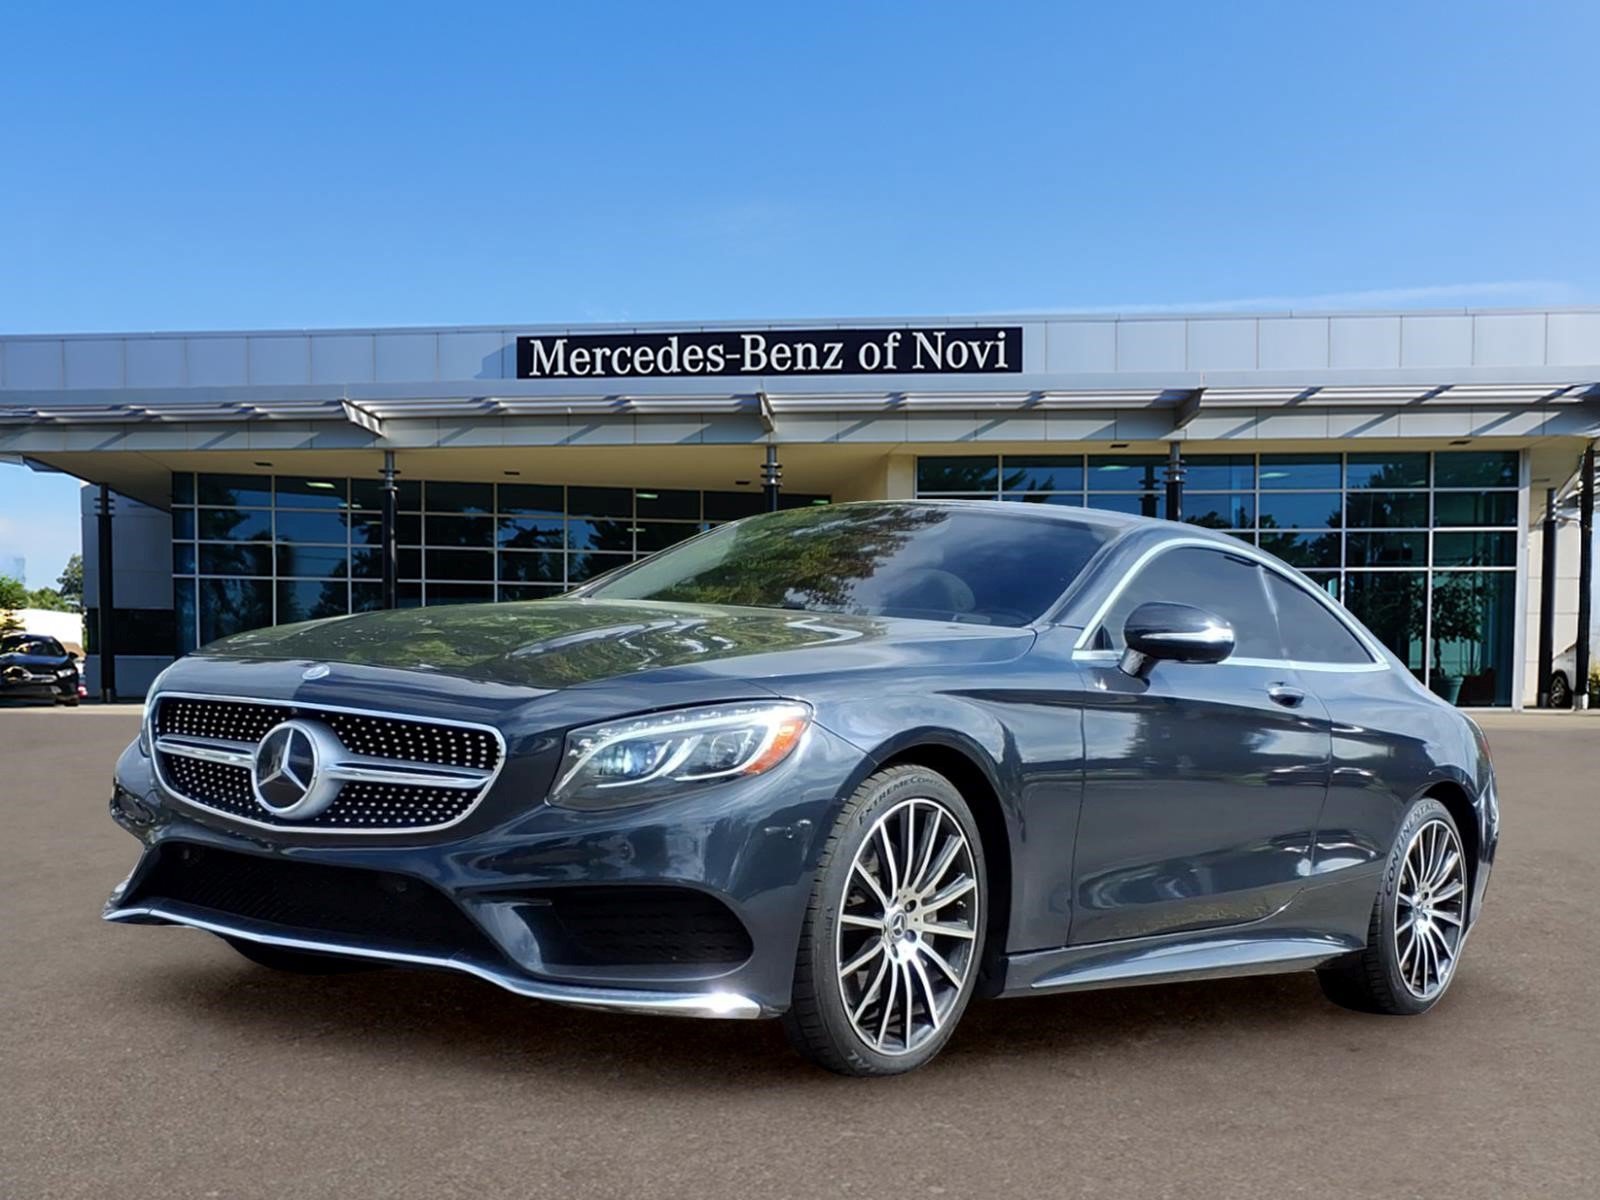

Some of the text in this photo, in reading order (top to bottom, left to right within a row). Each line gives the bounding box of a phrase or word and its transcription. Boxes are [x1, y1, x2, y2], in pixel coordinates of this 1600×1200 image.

[529, 331, 1009, 376] Mercedes-Benz of Novi
